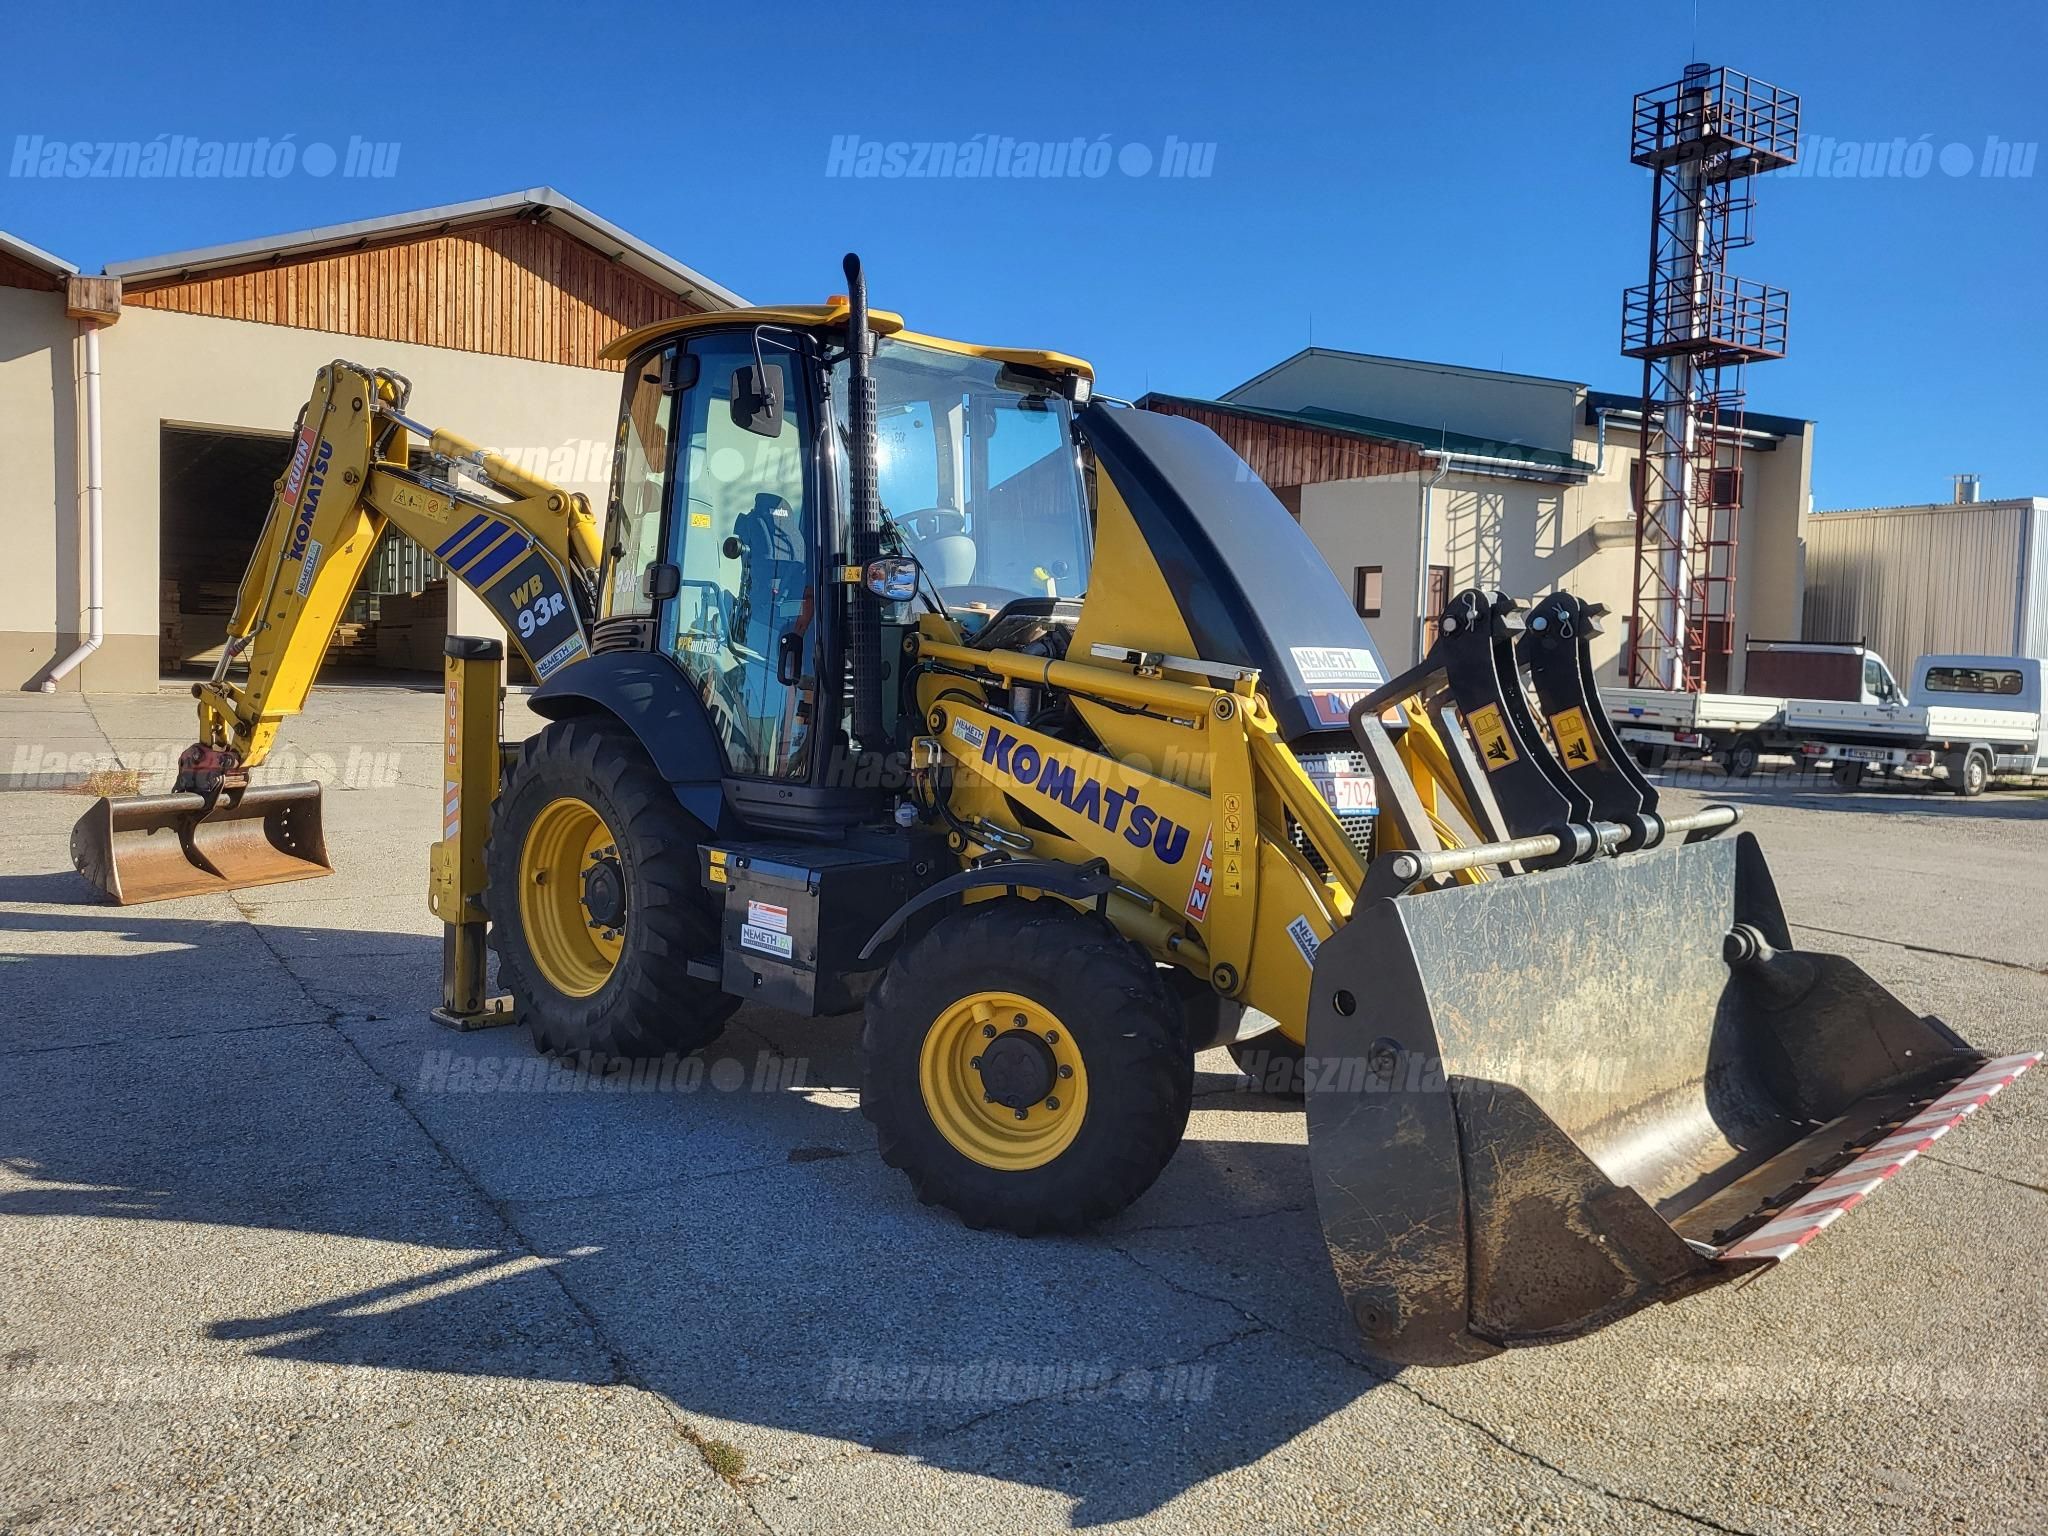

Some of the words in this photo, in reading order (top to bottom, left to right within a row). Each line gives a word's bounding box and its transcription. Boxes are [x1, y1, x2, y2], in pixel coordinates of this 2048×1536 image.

[288, 438, 310, 495] KUHN
[291, 440, 334, 562] KOMATSU
[509, 574, 544, 610] WB
[518, 592, 566, 639] 93R
[982, 726, 1191, 865] KOMATSU
